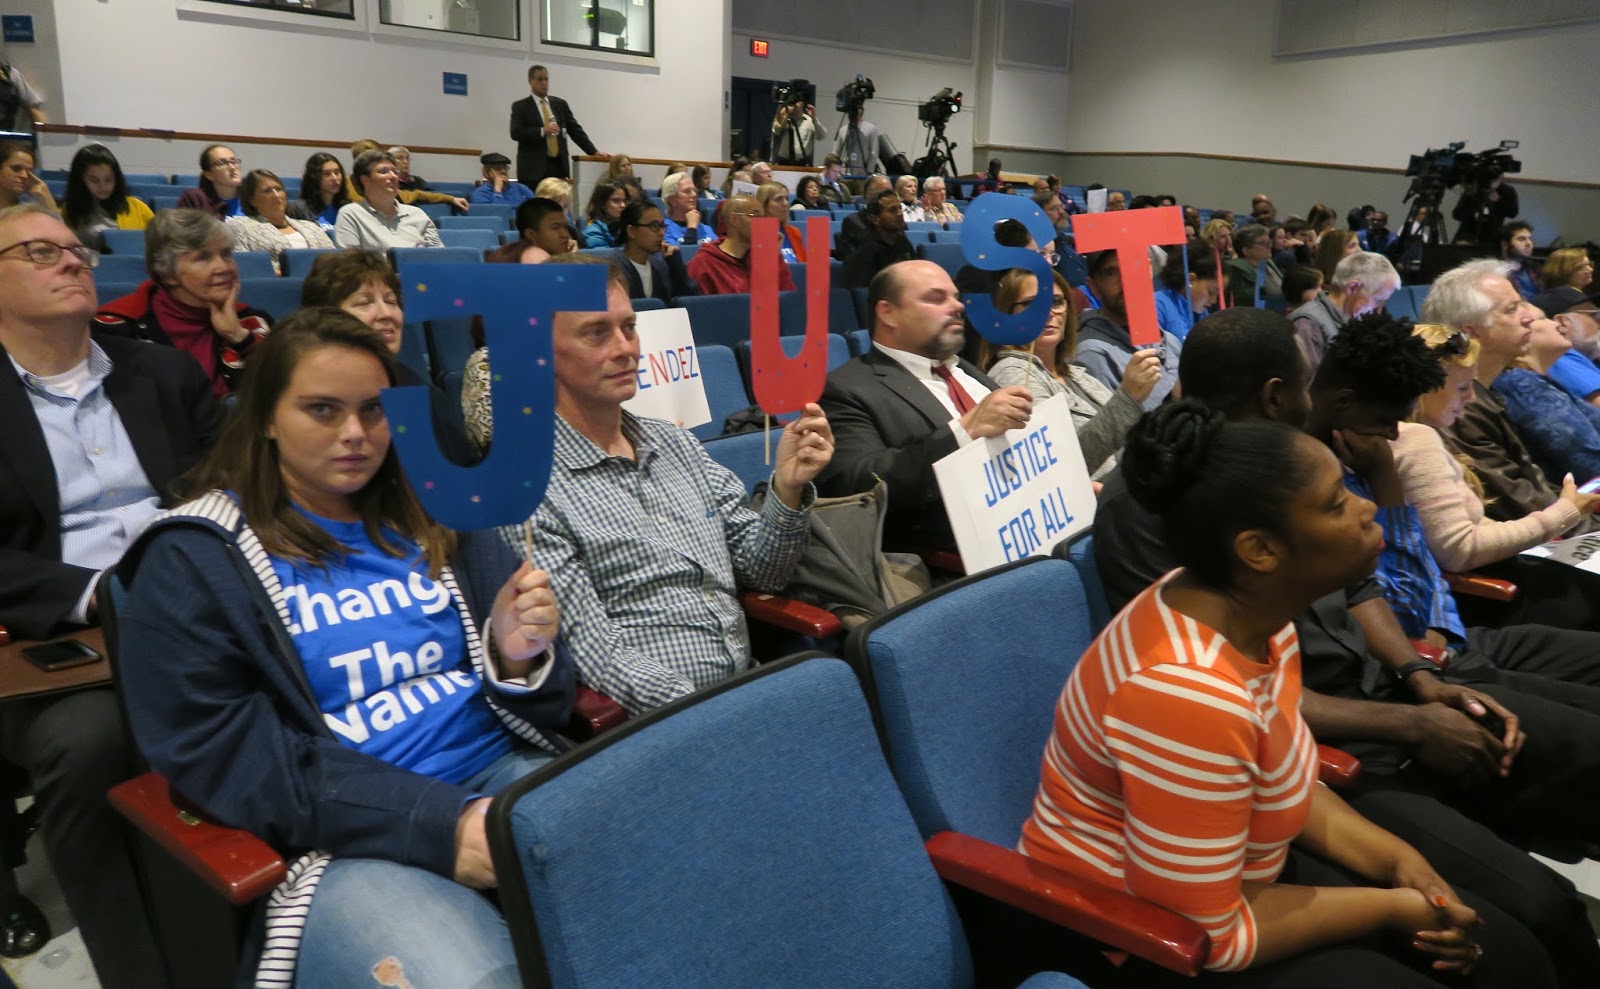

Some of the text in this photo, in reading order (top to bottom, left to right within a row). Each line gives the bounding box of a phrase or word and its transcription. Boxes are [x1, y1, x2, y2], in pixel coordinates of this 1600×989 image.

[983, 425, 1058, 508] JUSTICE
[998, 487, 1074, 563] FOR ALL
[329, 641, 444, 702] The
